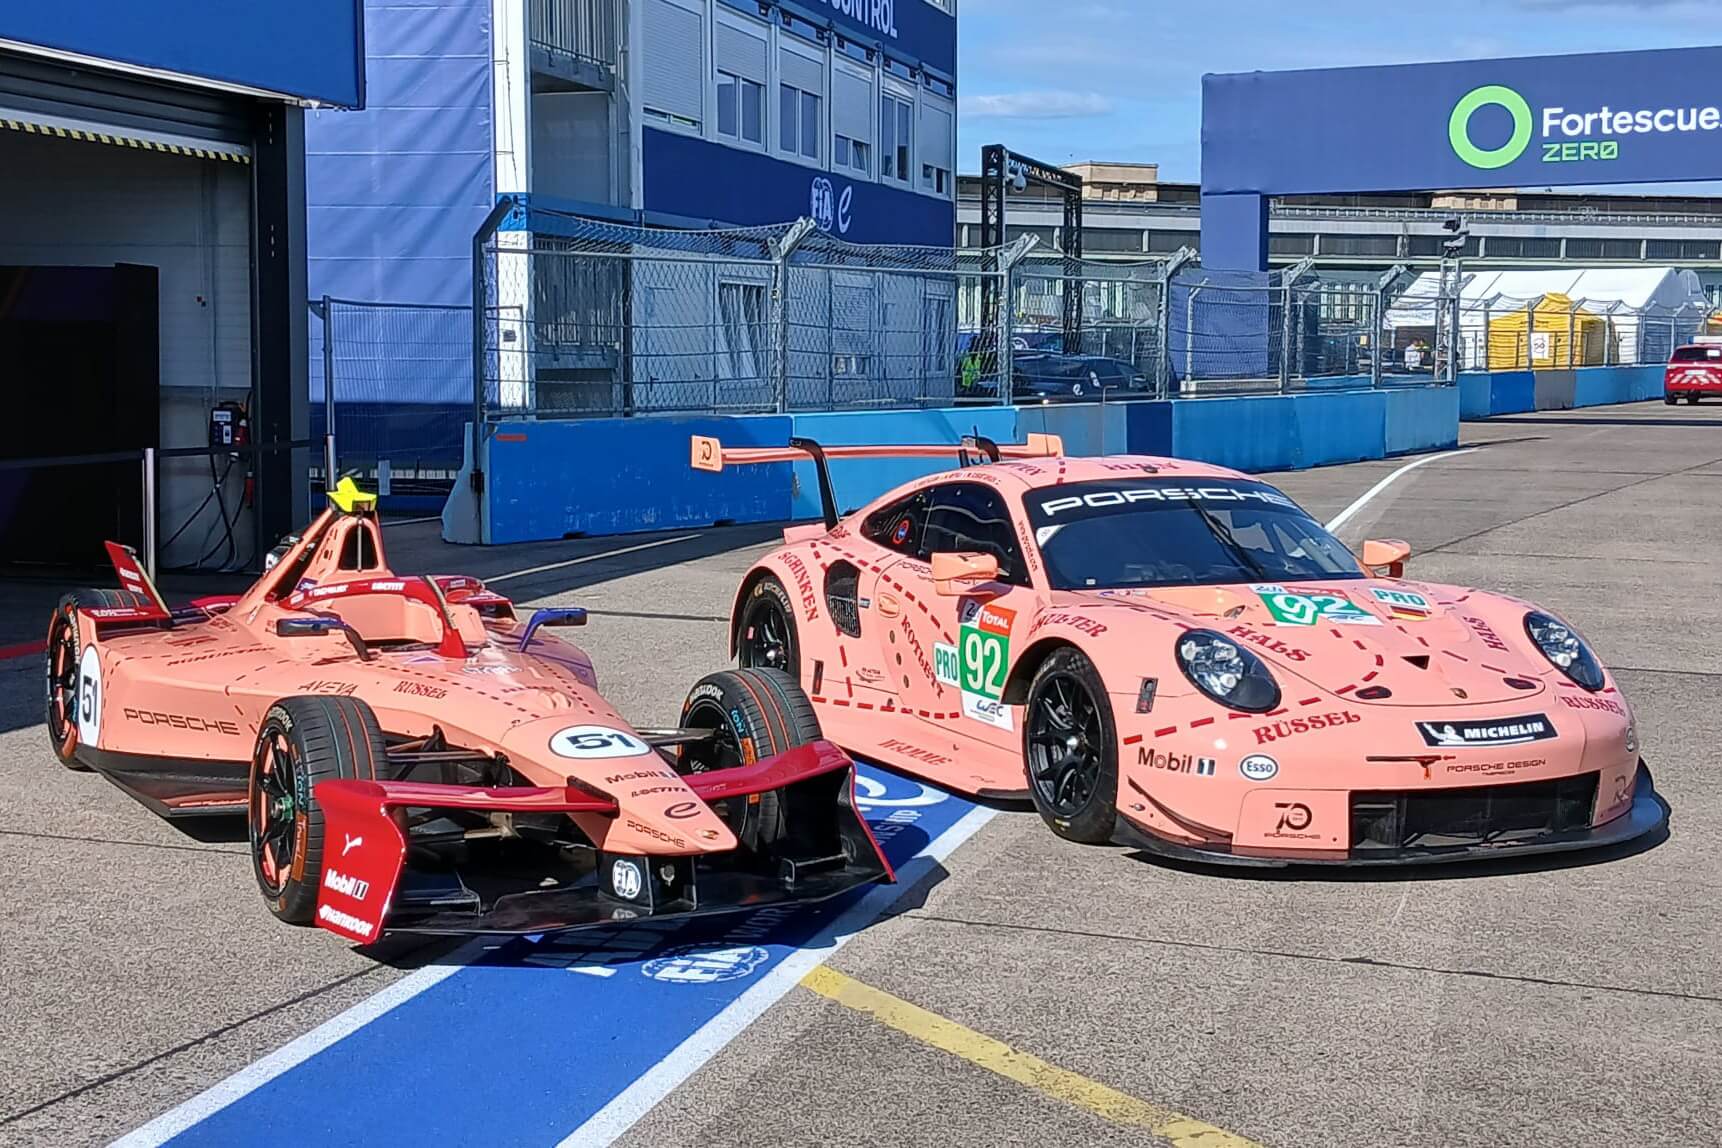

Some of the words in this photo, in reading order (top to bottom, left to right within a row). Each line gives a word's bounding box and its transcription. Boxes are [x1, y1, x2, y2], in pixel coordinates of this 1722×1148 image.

[831, 0, 898, 38] NTROL
[811, 180, 834, 228] FIA
[1041, 487, 1298, 516] PORSCHE
[1271, 594, 1361, 625] 92
[1373, 589, 1427, 606] PRO
[982, 611, 1009, 629] TOTAL
[1226, 625, 1312, 662] HALS
[936, 648, 958, 682] PRO
[965, 632, 1003, 697] 92
[82, 675, 99, 727] 51
[298, 680, 358, 696] AVEVA
[123, 708, 241, 735] PORSCHE
[1464, 721, 1545, 739] MICHELIN
[565, 733, 636, 750] 51
[1138, 746, 1193, 774] Mobil
[1245, 757, 1274, 775] Esso
[1446, 762, 1505, 773] PORSCHE
[1507, 759, 1547, 771] DESIGN
[605, 769, 658, 785] Mobil
[627, 819, 685, 849] PORSCHE
[324, 868, 354, 897] Mobil
[613, 861, 641, 898] FIA
